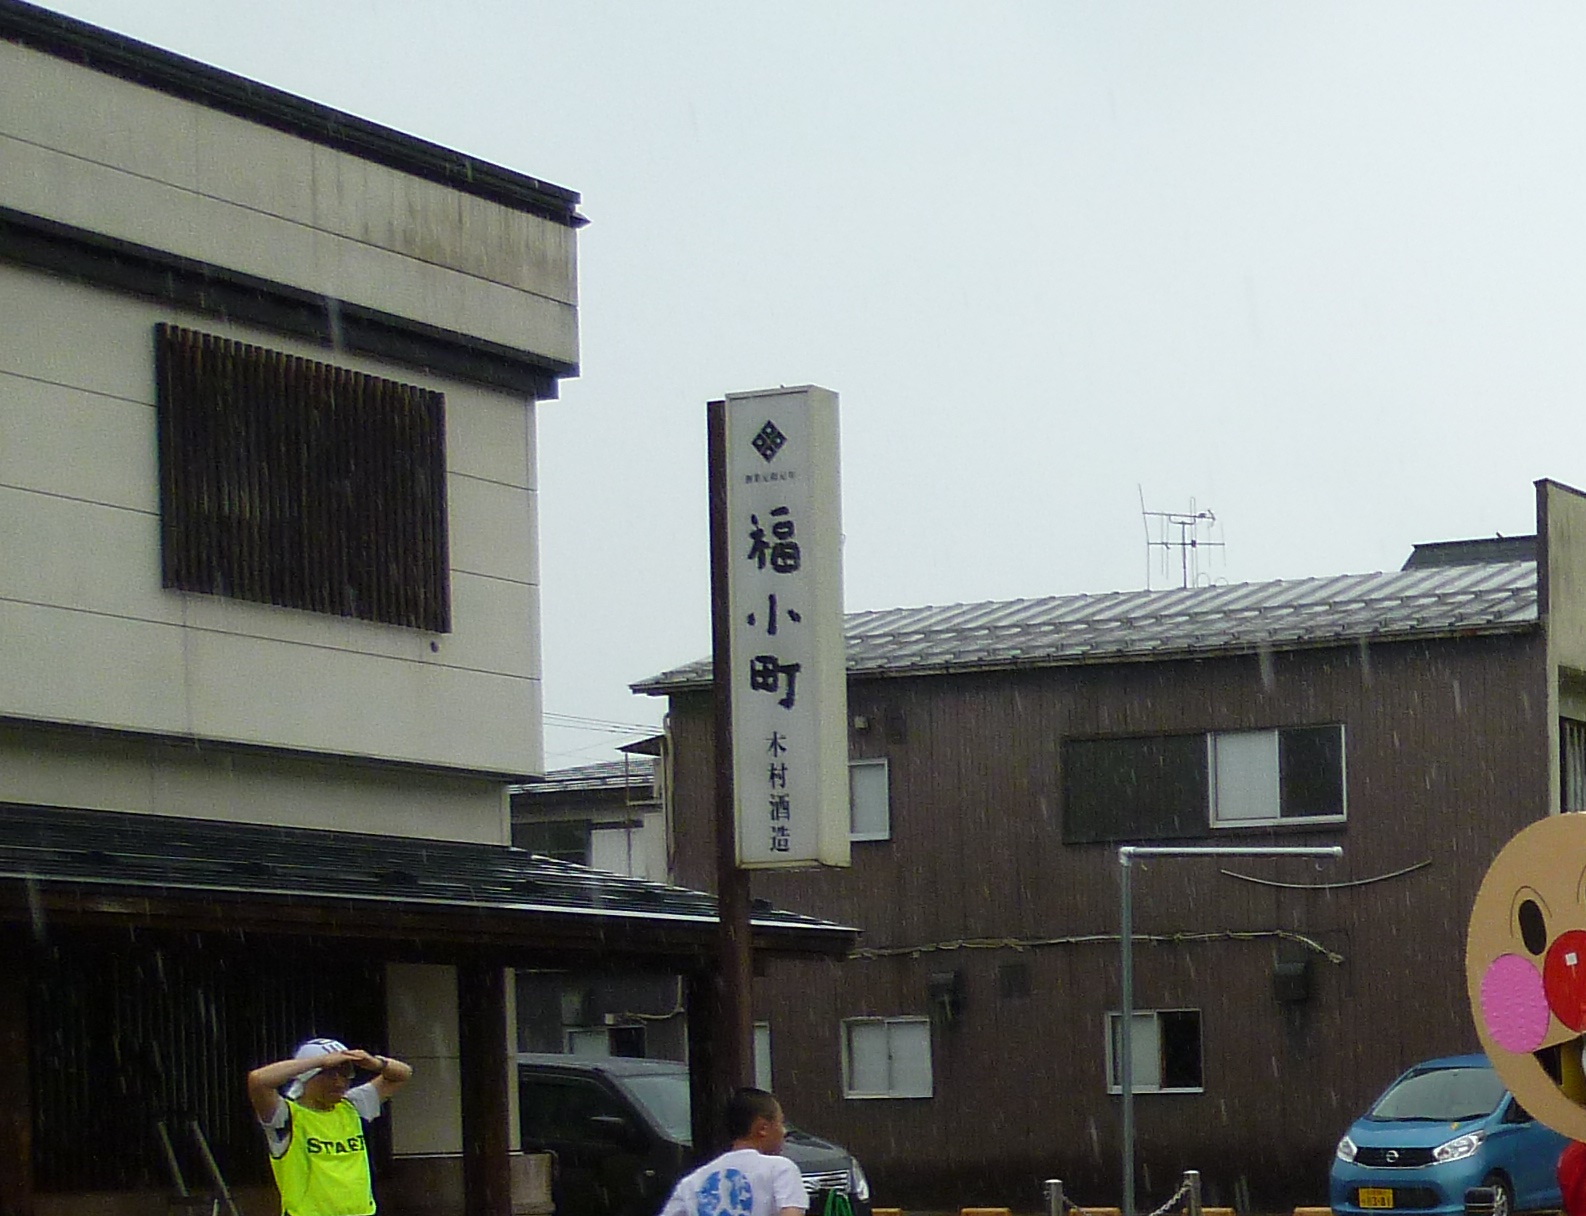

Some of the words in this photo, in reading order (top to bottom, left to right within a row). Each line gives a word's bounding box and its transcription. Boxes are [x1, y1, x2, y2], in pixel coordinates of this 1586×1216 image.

[746, 506, 801, 710] 福小町
[766, 731, 791, 854] 木村酒造
